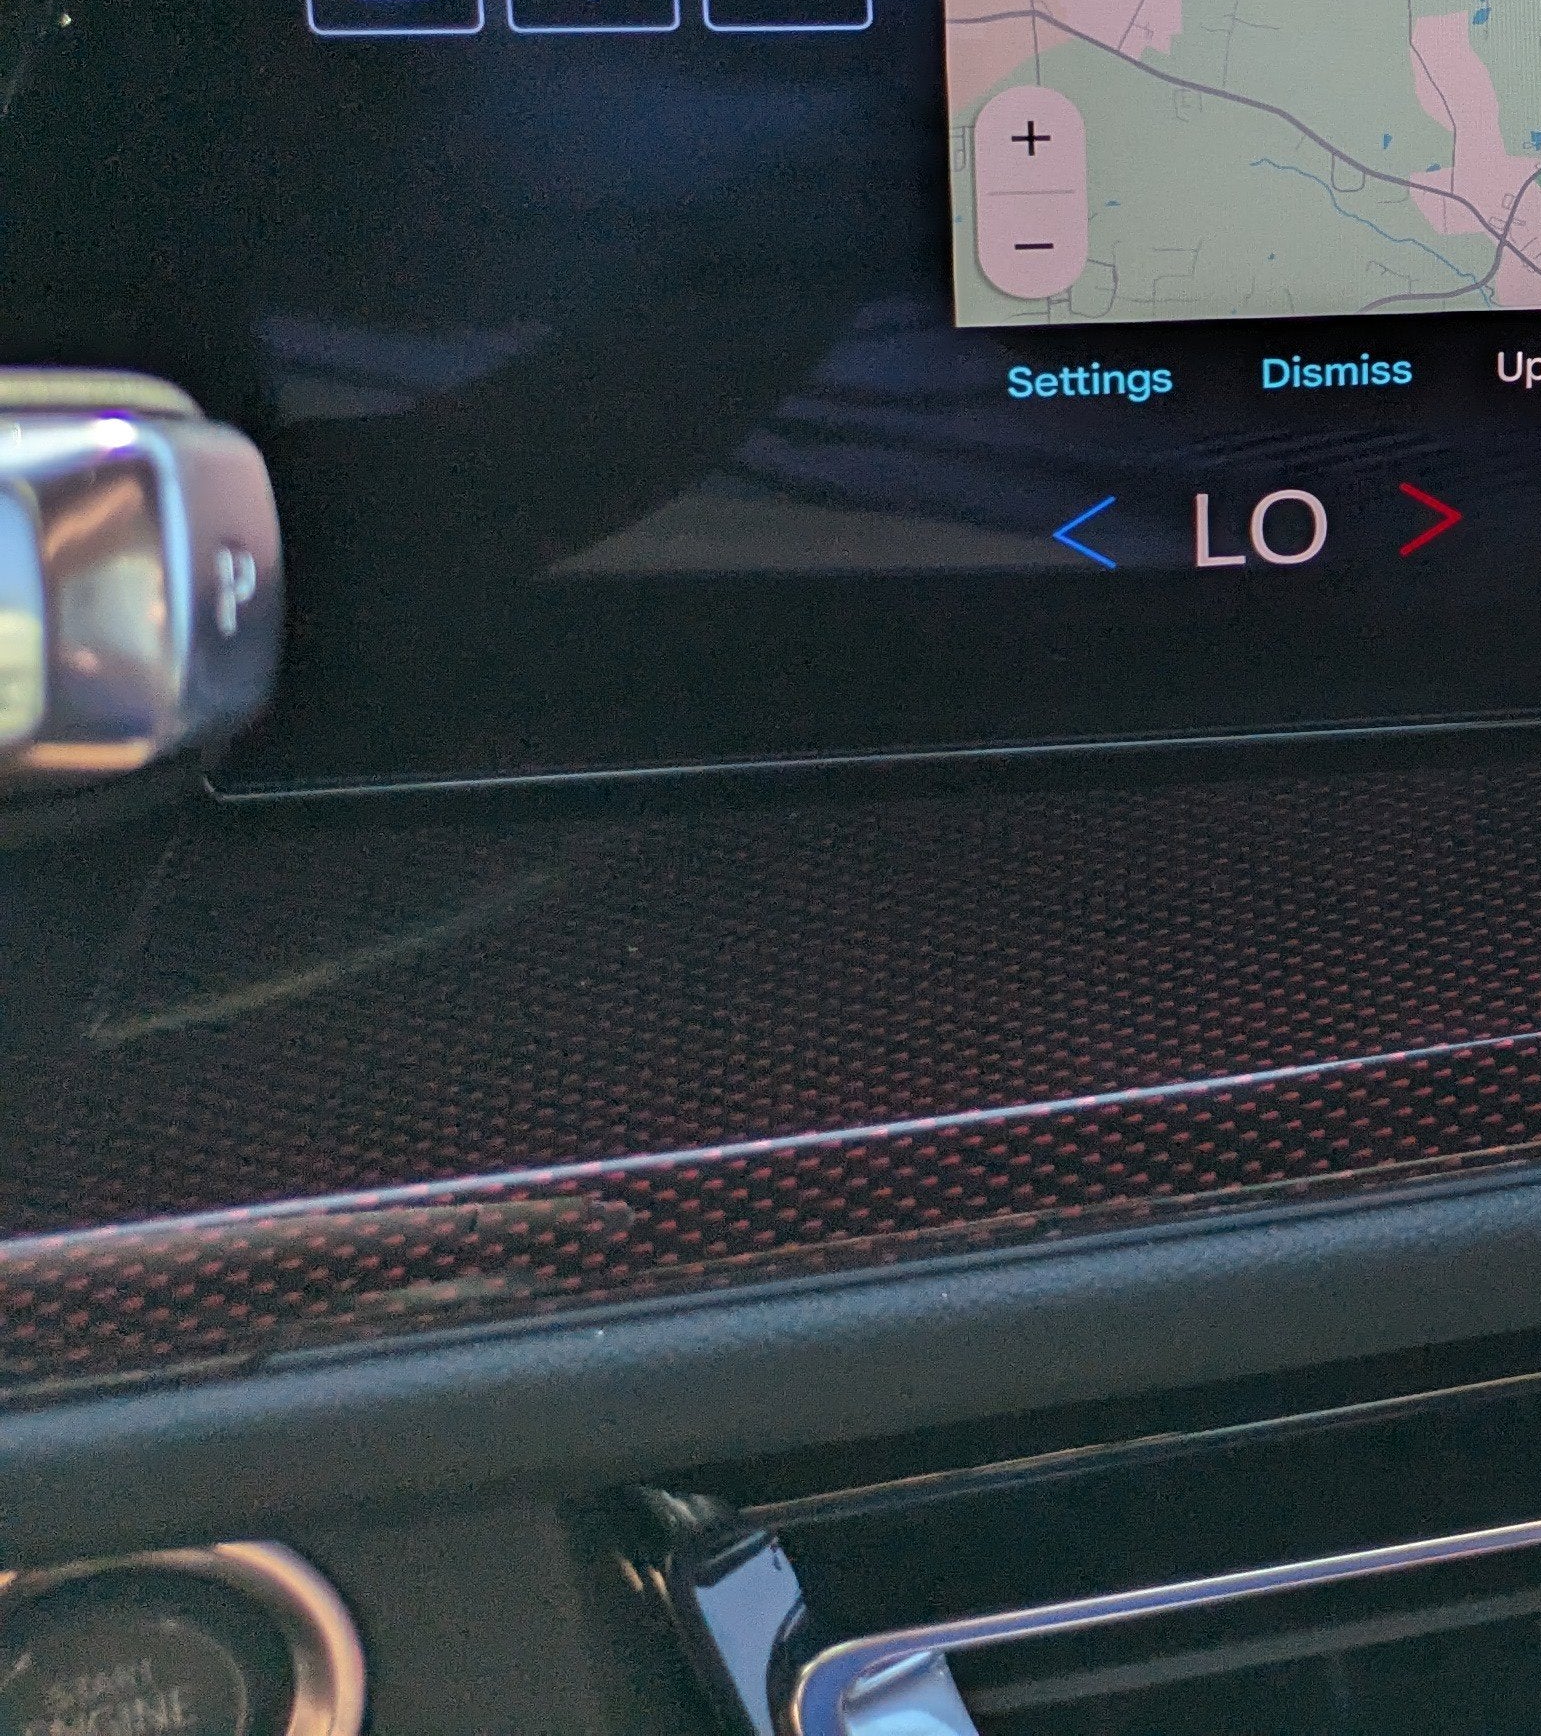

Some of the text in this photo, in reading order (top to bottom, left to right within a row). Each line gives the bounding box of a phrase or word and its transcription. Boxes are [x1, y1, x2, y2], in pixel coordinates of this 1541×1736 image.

[1006, 360, 1174, 404] Settings
[1261, 351, 1414, 391] Dismiss
[1194, 487, 1329, 569] LO
